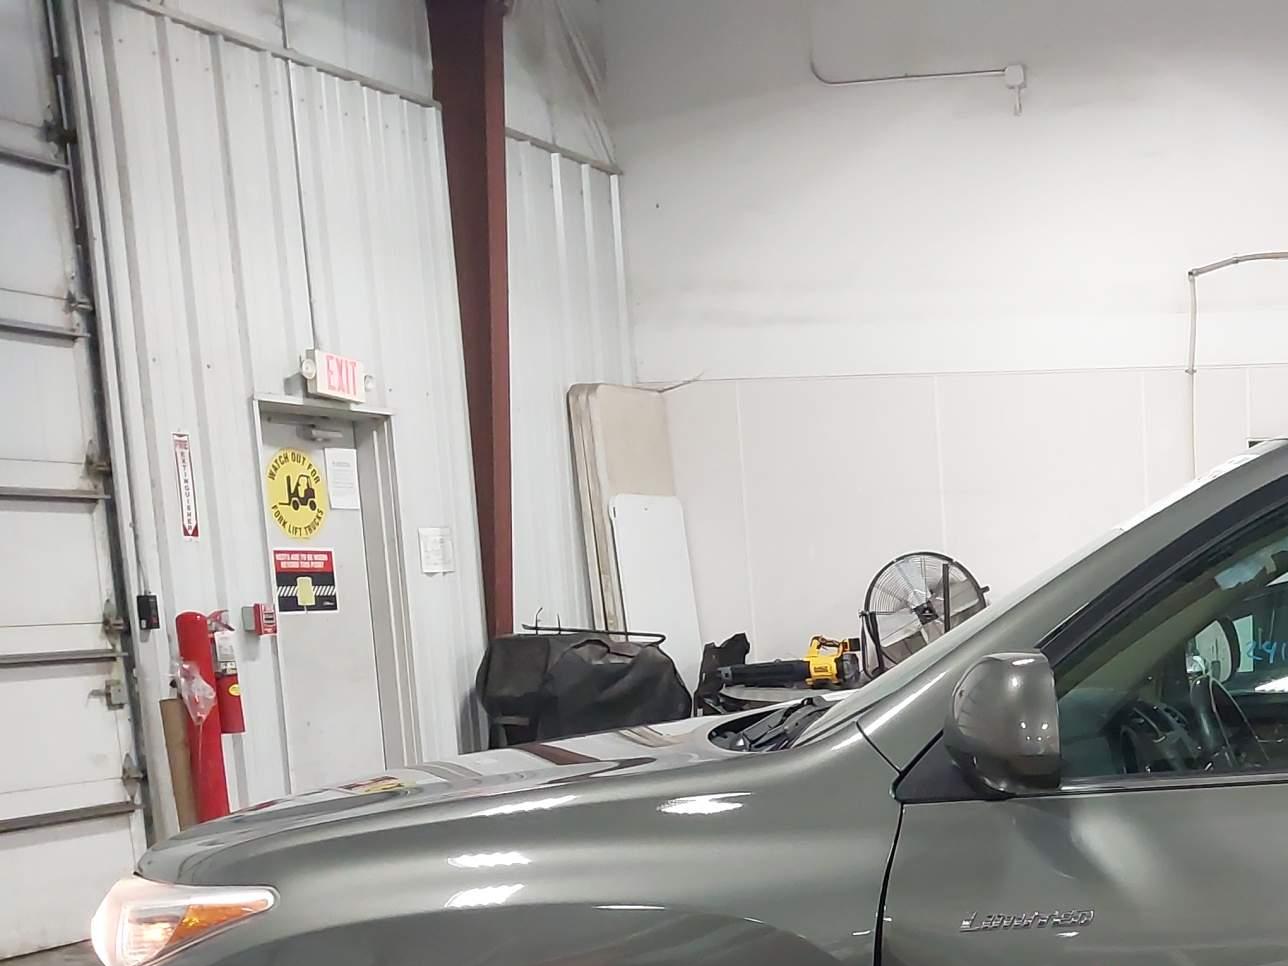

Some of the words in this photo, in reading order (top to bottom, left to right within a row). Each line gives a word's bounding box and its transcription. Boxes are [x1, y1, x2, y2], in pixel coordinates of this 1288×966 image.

[326, 355, 357, 395] EXIT
[268, 452, 290, 480] WATCH
[290, 452, 306, 465] OUT
[307, 463, 320, 484] FOR
[180, 451, 193, 531] EXTINGUISHER
[271, 504, 288, 528] FORK
[287, 524, 302, 537] LIFT
[303, 508, 324, 536] TRUCKS
